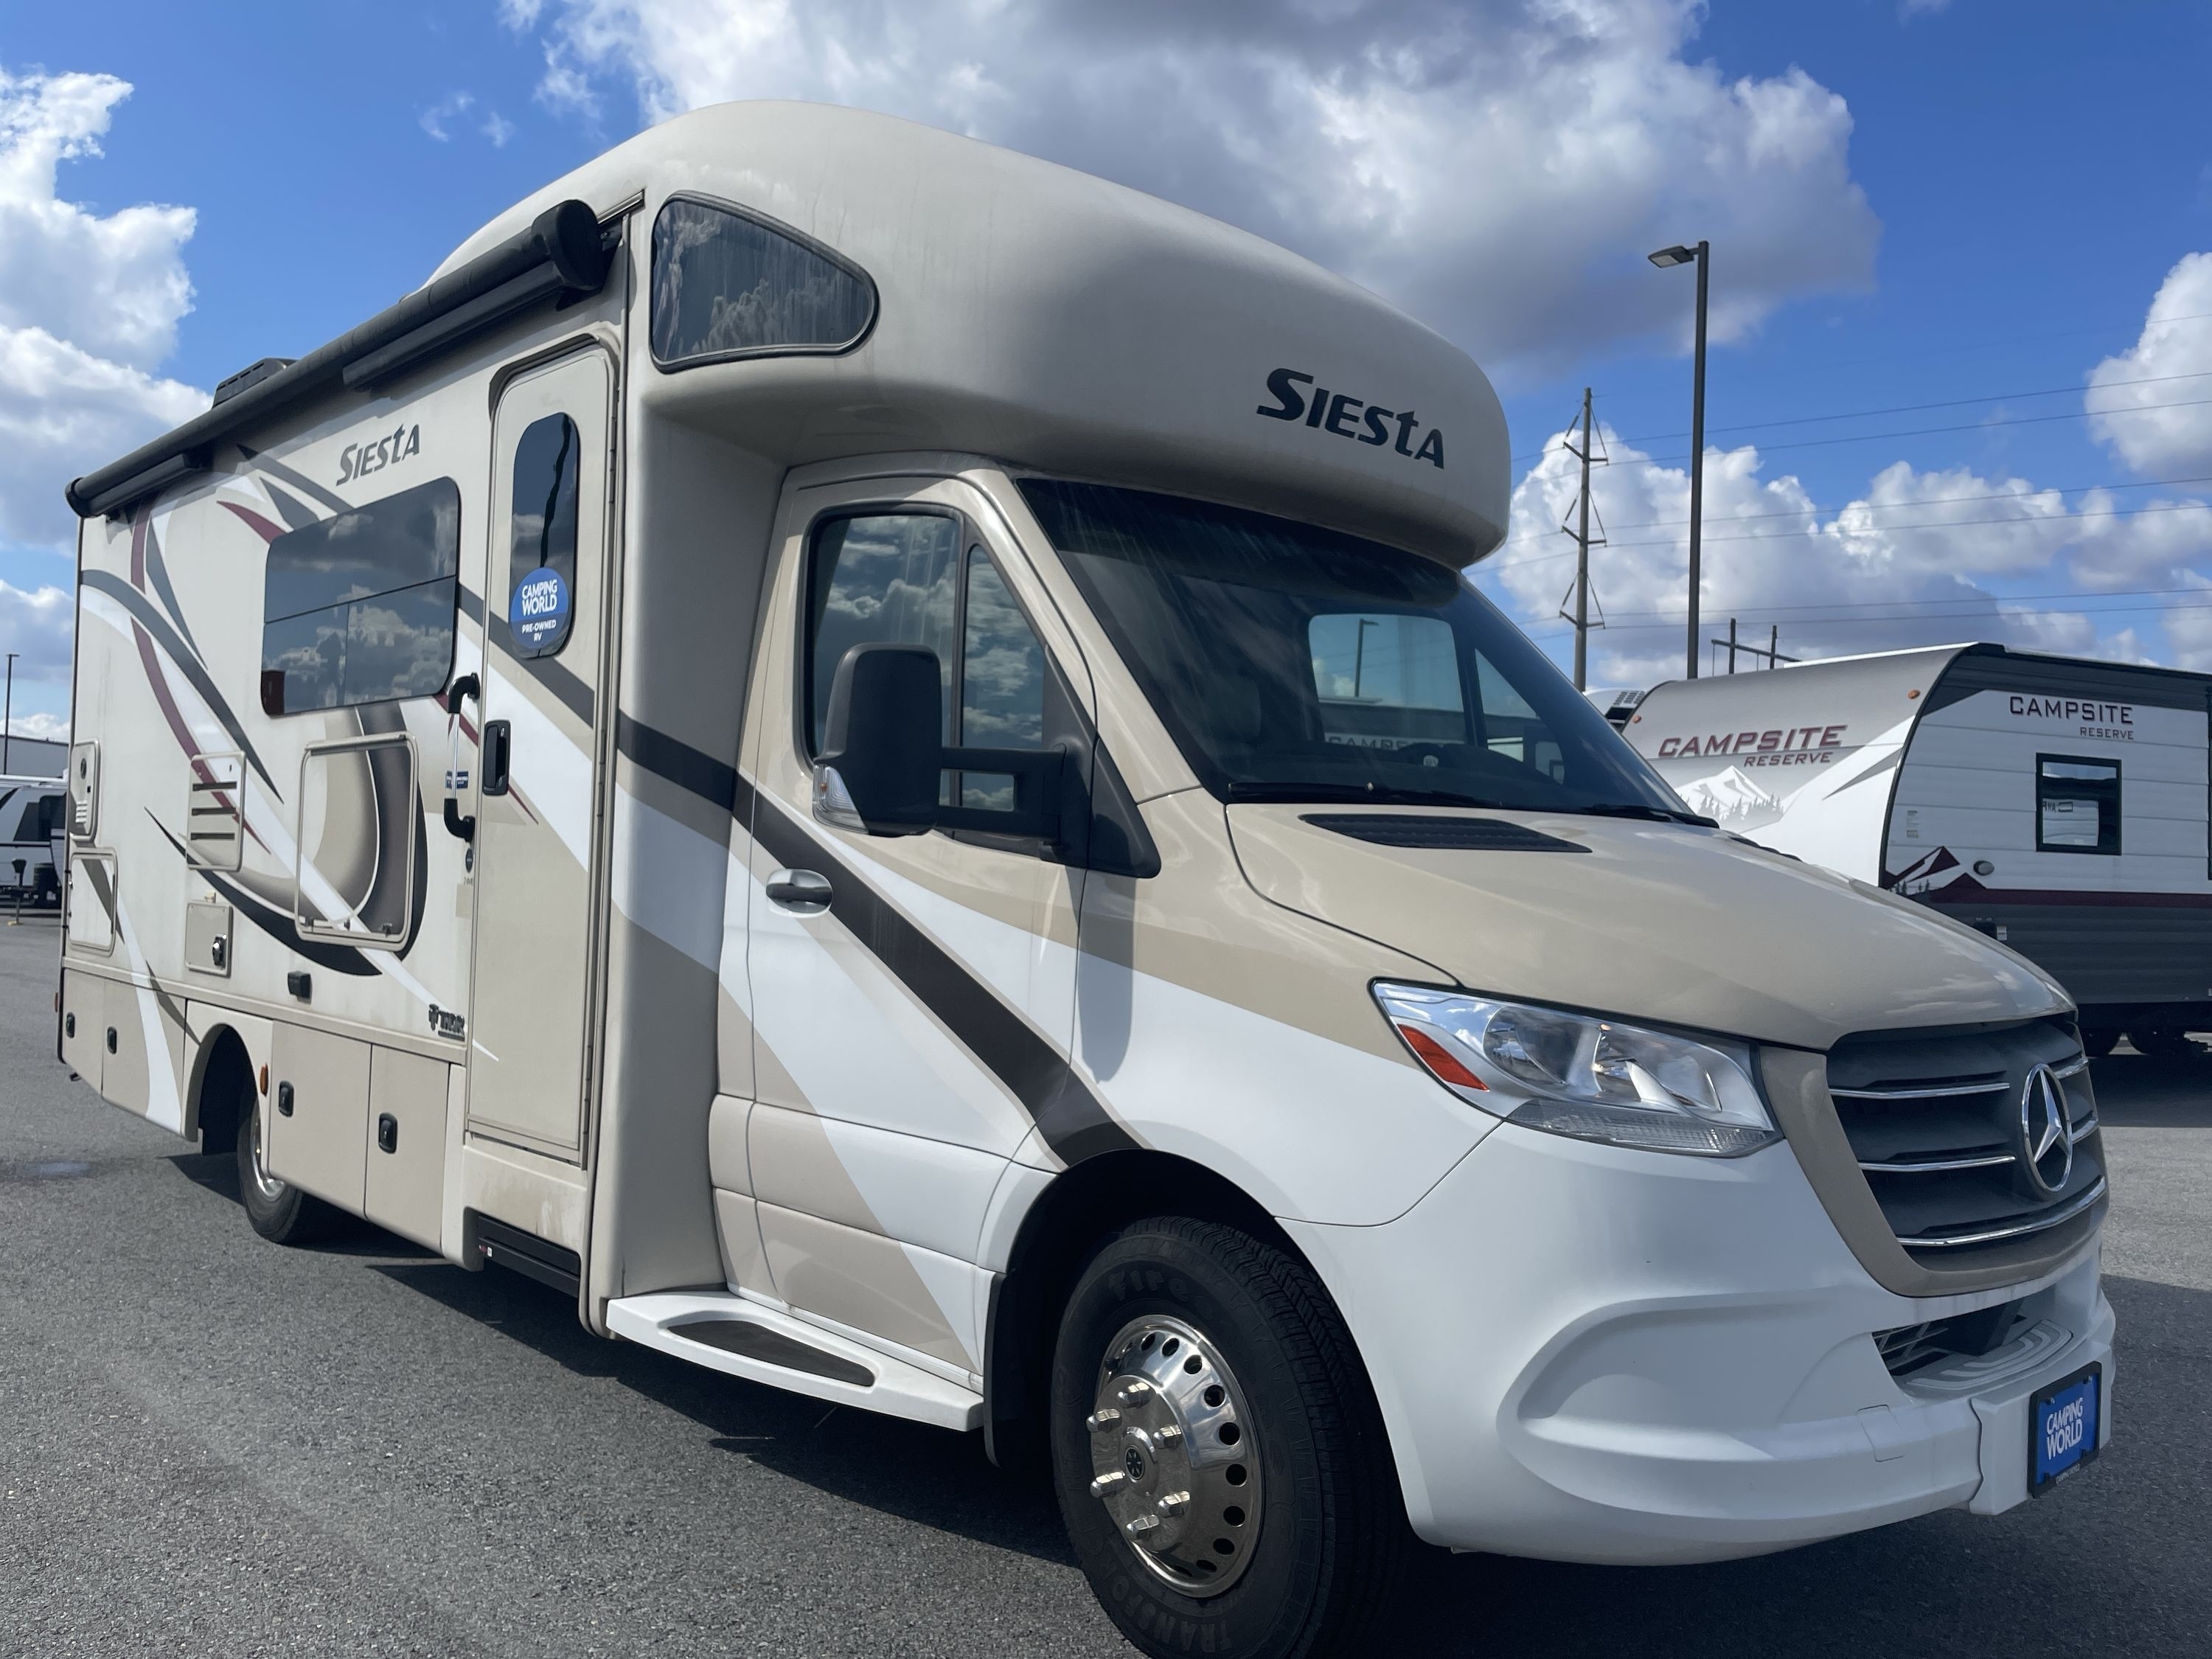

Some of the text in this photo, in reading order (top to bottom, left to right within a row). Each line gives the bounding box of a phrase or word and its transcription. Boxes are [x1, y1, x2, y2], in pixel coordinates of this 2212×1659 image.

[522, 579, 558, 599] CAMPING
[522, 594, 557, 616] WORLD
[522, 619, 557, 633] PRE-OWNED
[534, 632, 543, 642] RV
[2010, 696, 2134, 726] CAMPSITE
[1658, 725, 1847, 758] CAMPSITE
[2080, 726, 2135, 740] RESERVE
[1744, 752, 1833, 768] RESERVE
[2047, 1397, 2083, 1435] CAMPING
[2047, 1419, 2083, 1461] WORLD
